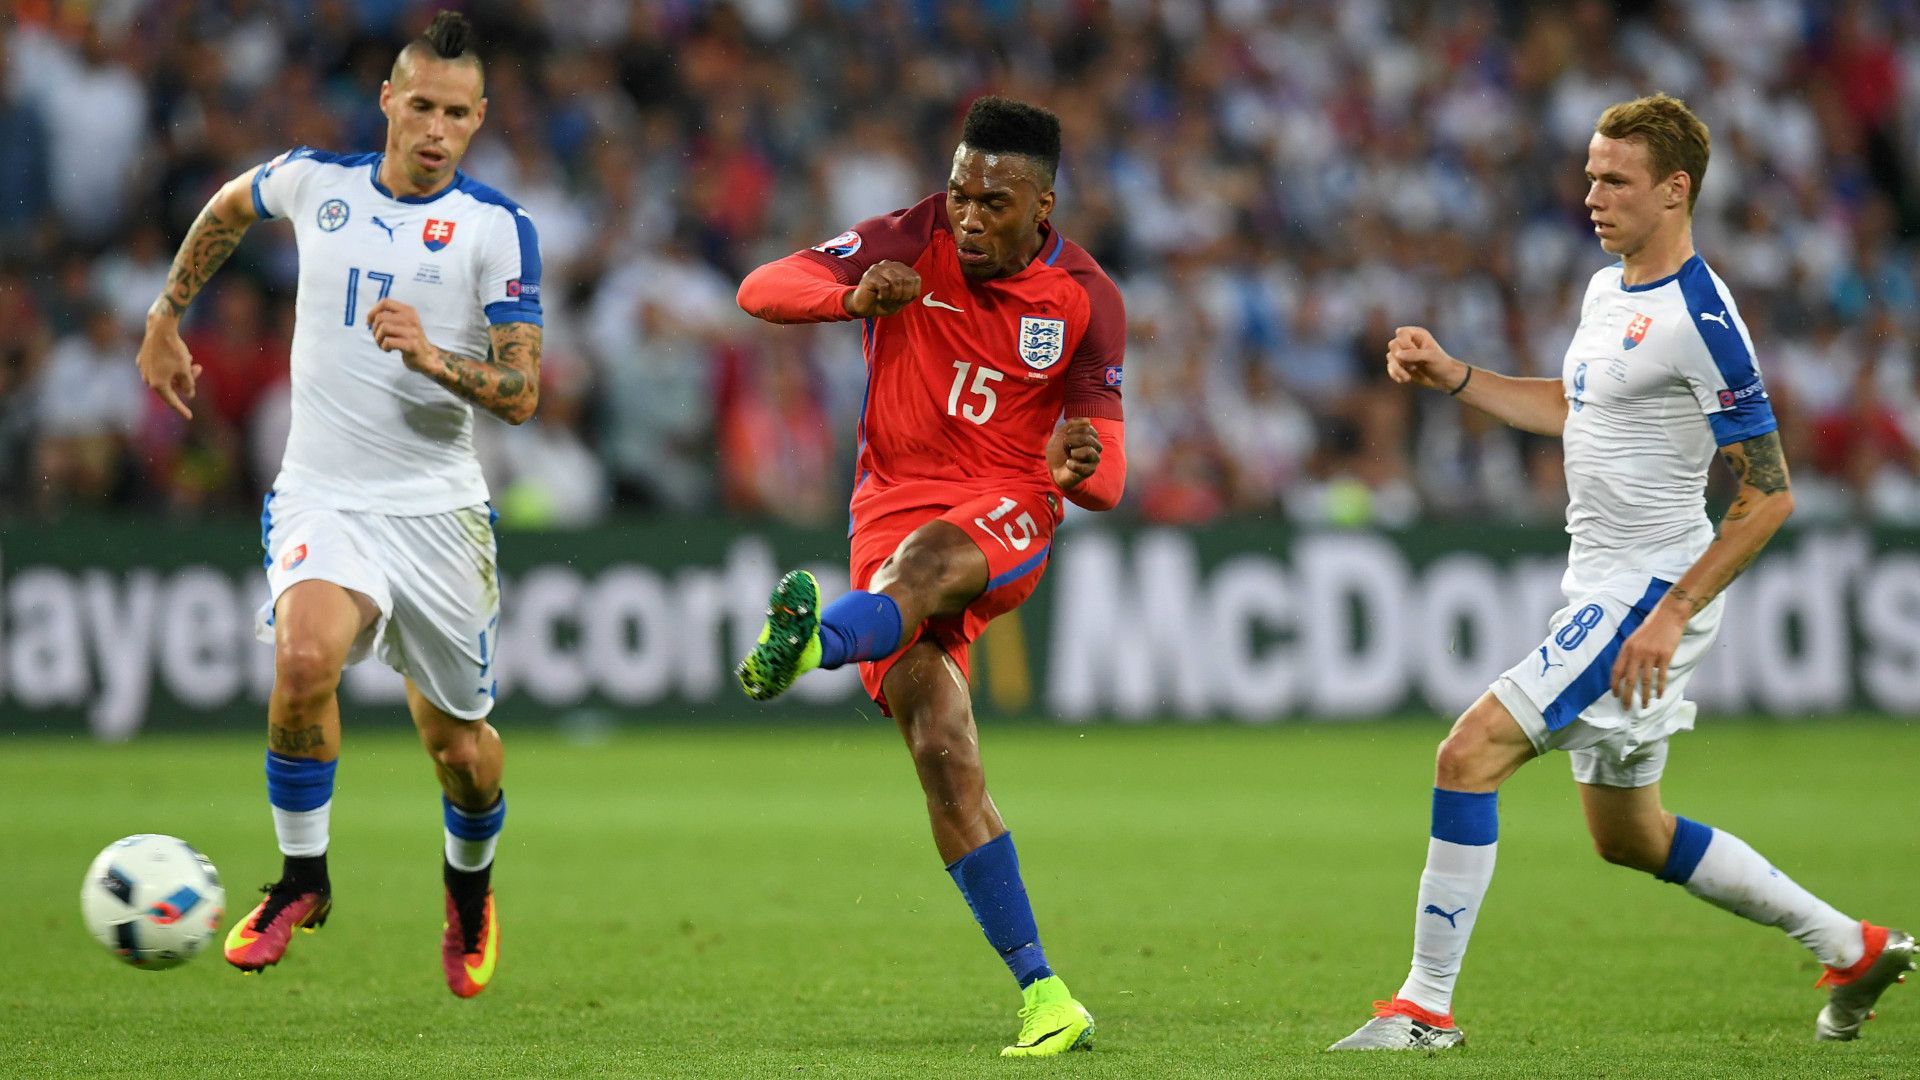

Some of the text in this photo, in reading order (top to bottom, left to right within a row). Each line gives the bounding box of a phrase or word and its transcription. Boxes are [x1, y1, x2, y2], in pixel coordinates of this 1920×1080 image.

[947, 360, 1004, 425] 15
[986, 496, 1039, 551] 15
[1555, 603, 1603, 651] 8
